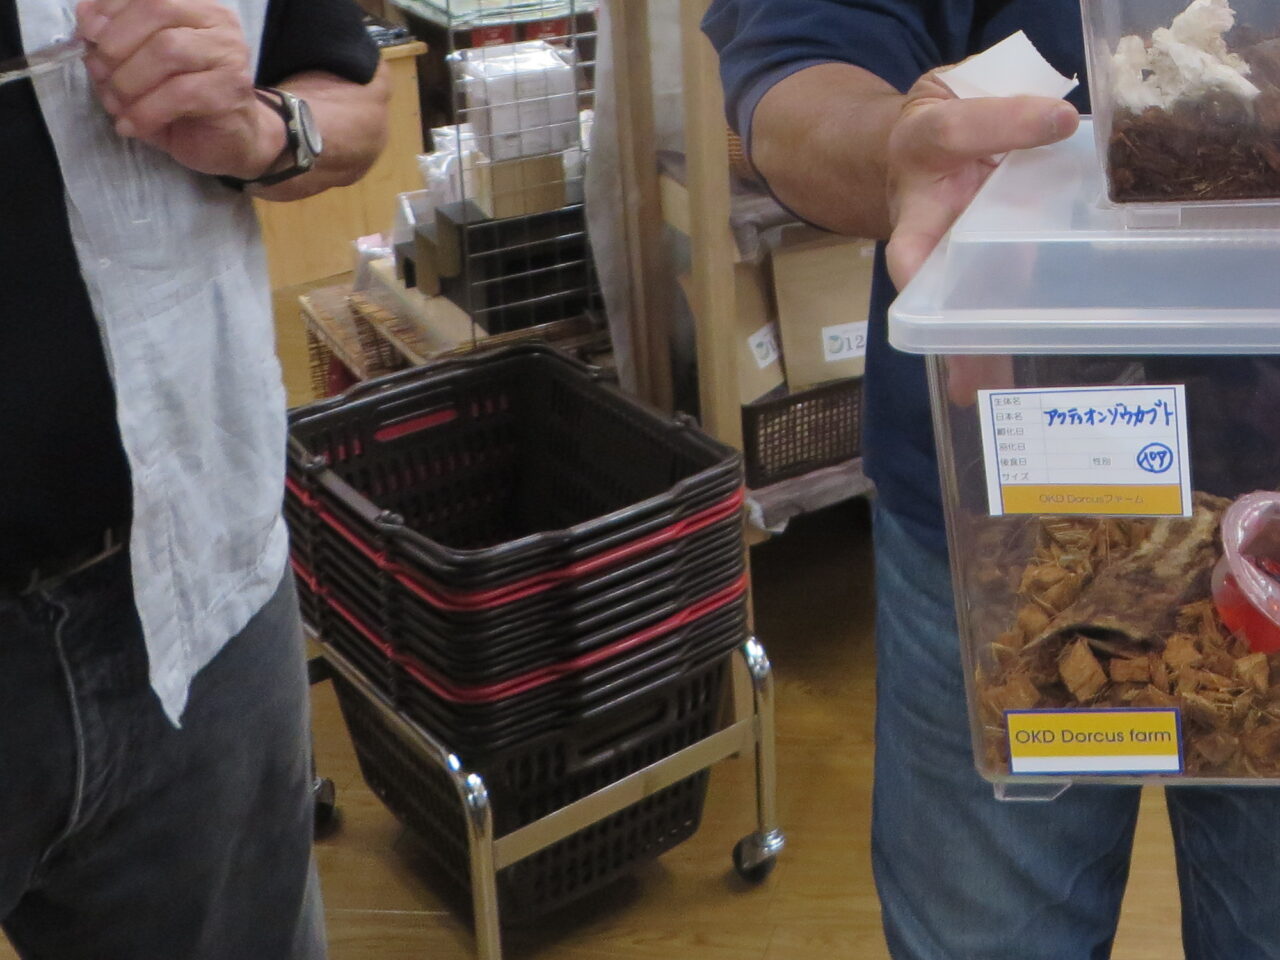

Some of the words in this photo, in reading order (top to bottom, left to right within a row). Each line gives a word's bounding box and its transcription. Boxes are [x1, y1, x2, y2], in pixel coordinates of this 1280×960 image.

[994, 396, 1022, 406] 生体名
[996, 412, 1023, 421] 日本名
[1043, 399, 1174, 427] アクティオンゾウカブト
[1092, 457, 1111, 466] 性別
[1002, 472, 1030, 481] サイズ
[1039, 494, 1065, 503] OKD
[1015, 730, 1056, 744] OKD
[1062, 729, 1124, 743] Dorcus
[1130, 728, 1172, 742] farm
